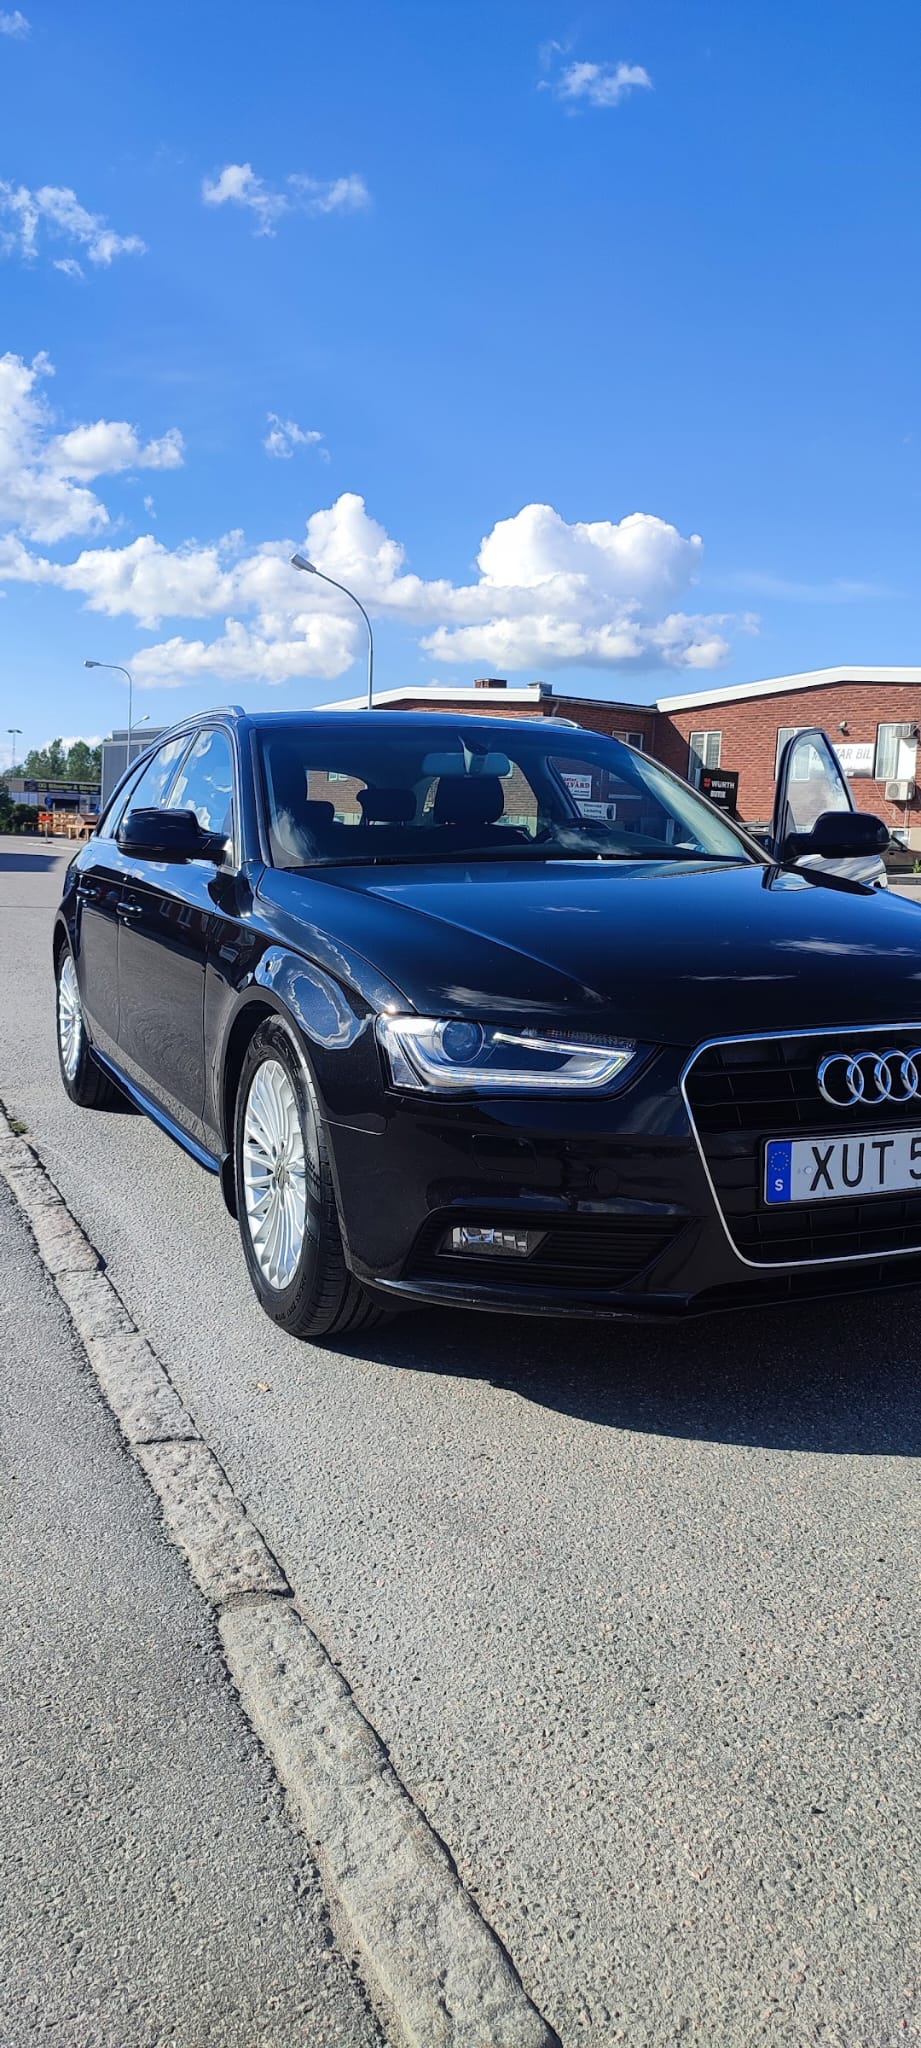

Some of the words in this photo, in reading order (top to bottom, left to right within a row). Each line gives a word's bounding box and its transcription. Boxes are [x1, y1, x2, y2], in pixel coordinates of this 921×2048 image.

[855, 747, 872, 760] BIL
[809, 1140, 895, 1192] XUT
[774, 1178, 784, 1192] S
